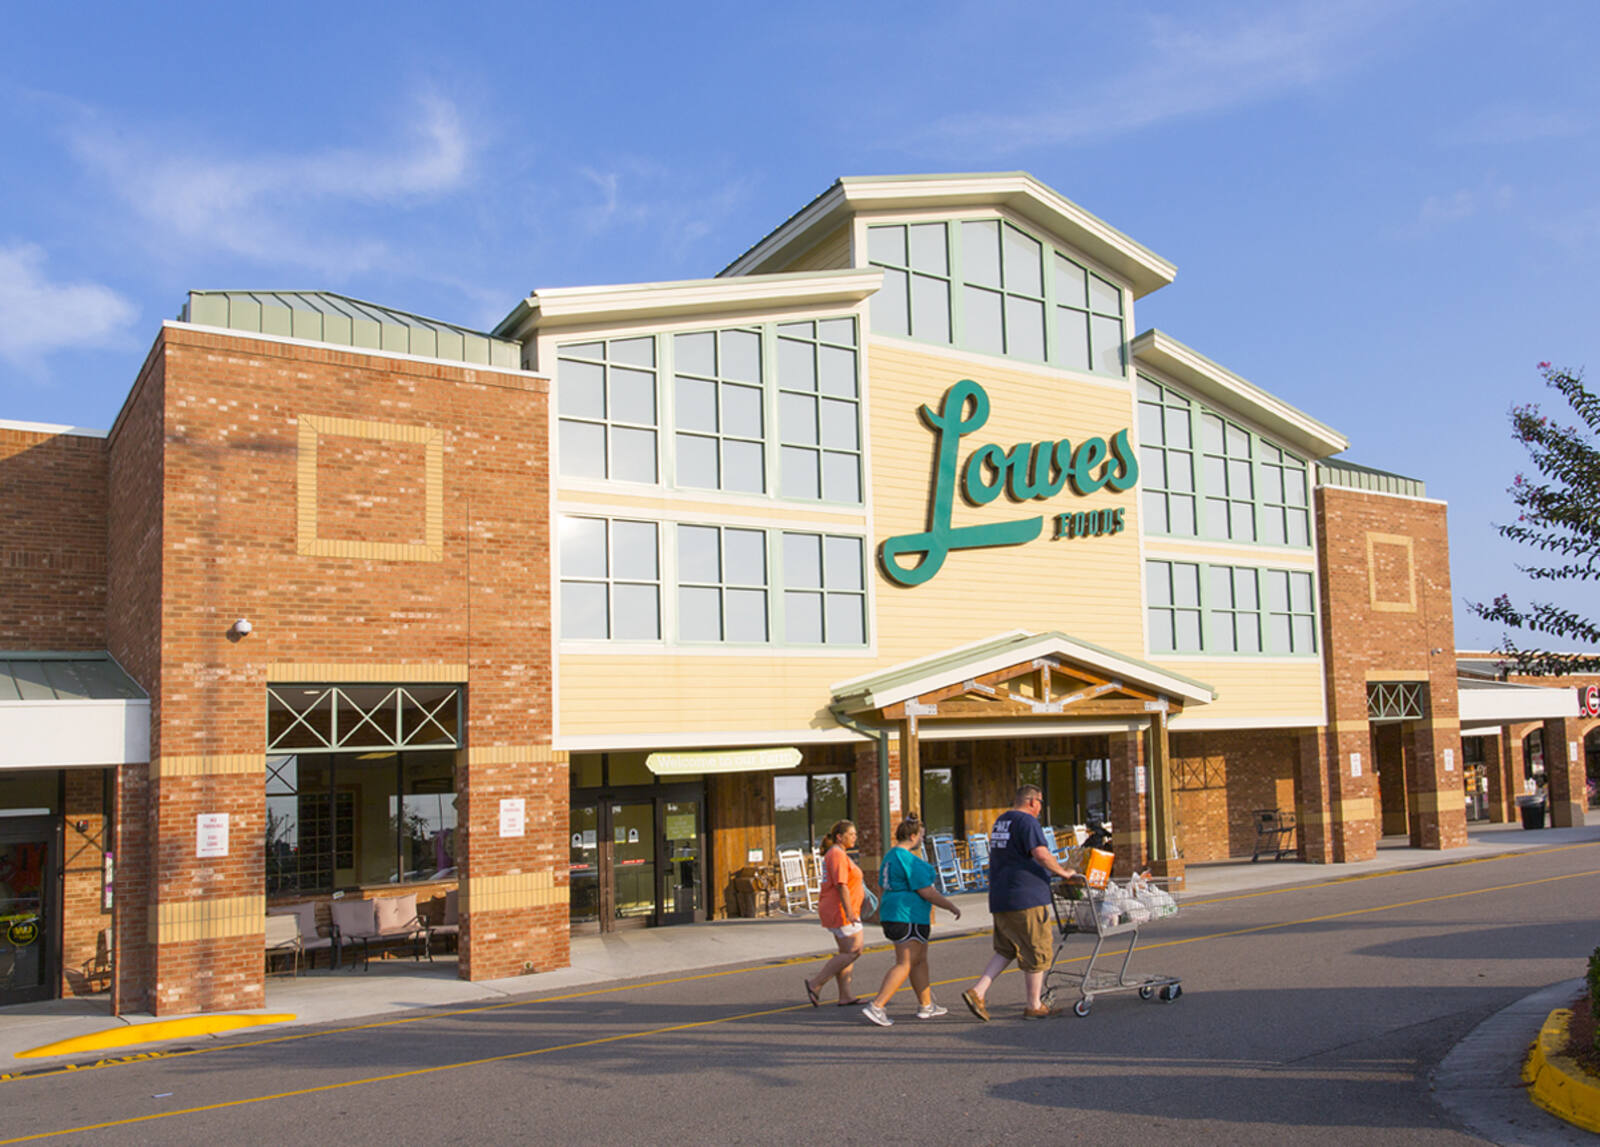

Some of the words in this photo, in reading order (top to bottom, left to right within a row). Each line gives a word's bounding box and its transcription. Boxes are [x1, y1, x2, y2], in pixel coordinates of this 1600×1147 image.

[876, 379, 1138, 587] Lowes
[1053, 507, 1125, 541] FOODS
[657, 755, 716, 768] Welcome
[719, 755, 732, 767] to
[735, 755, 756, 766] our
